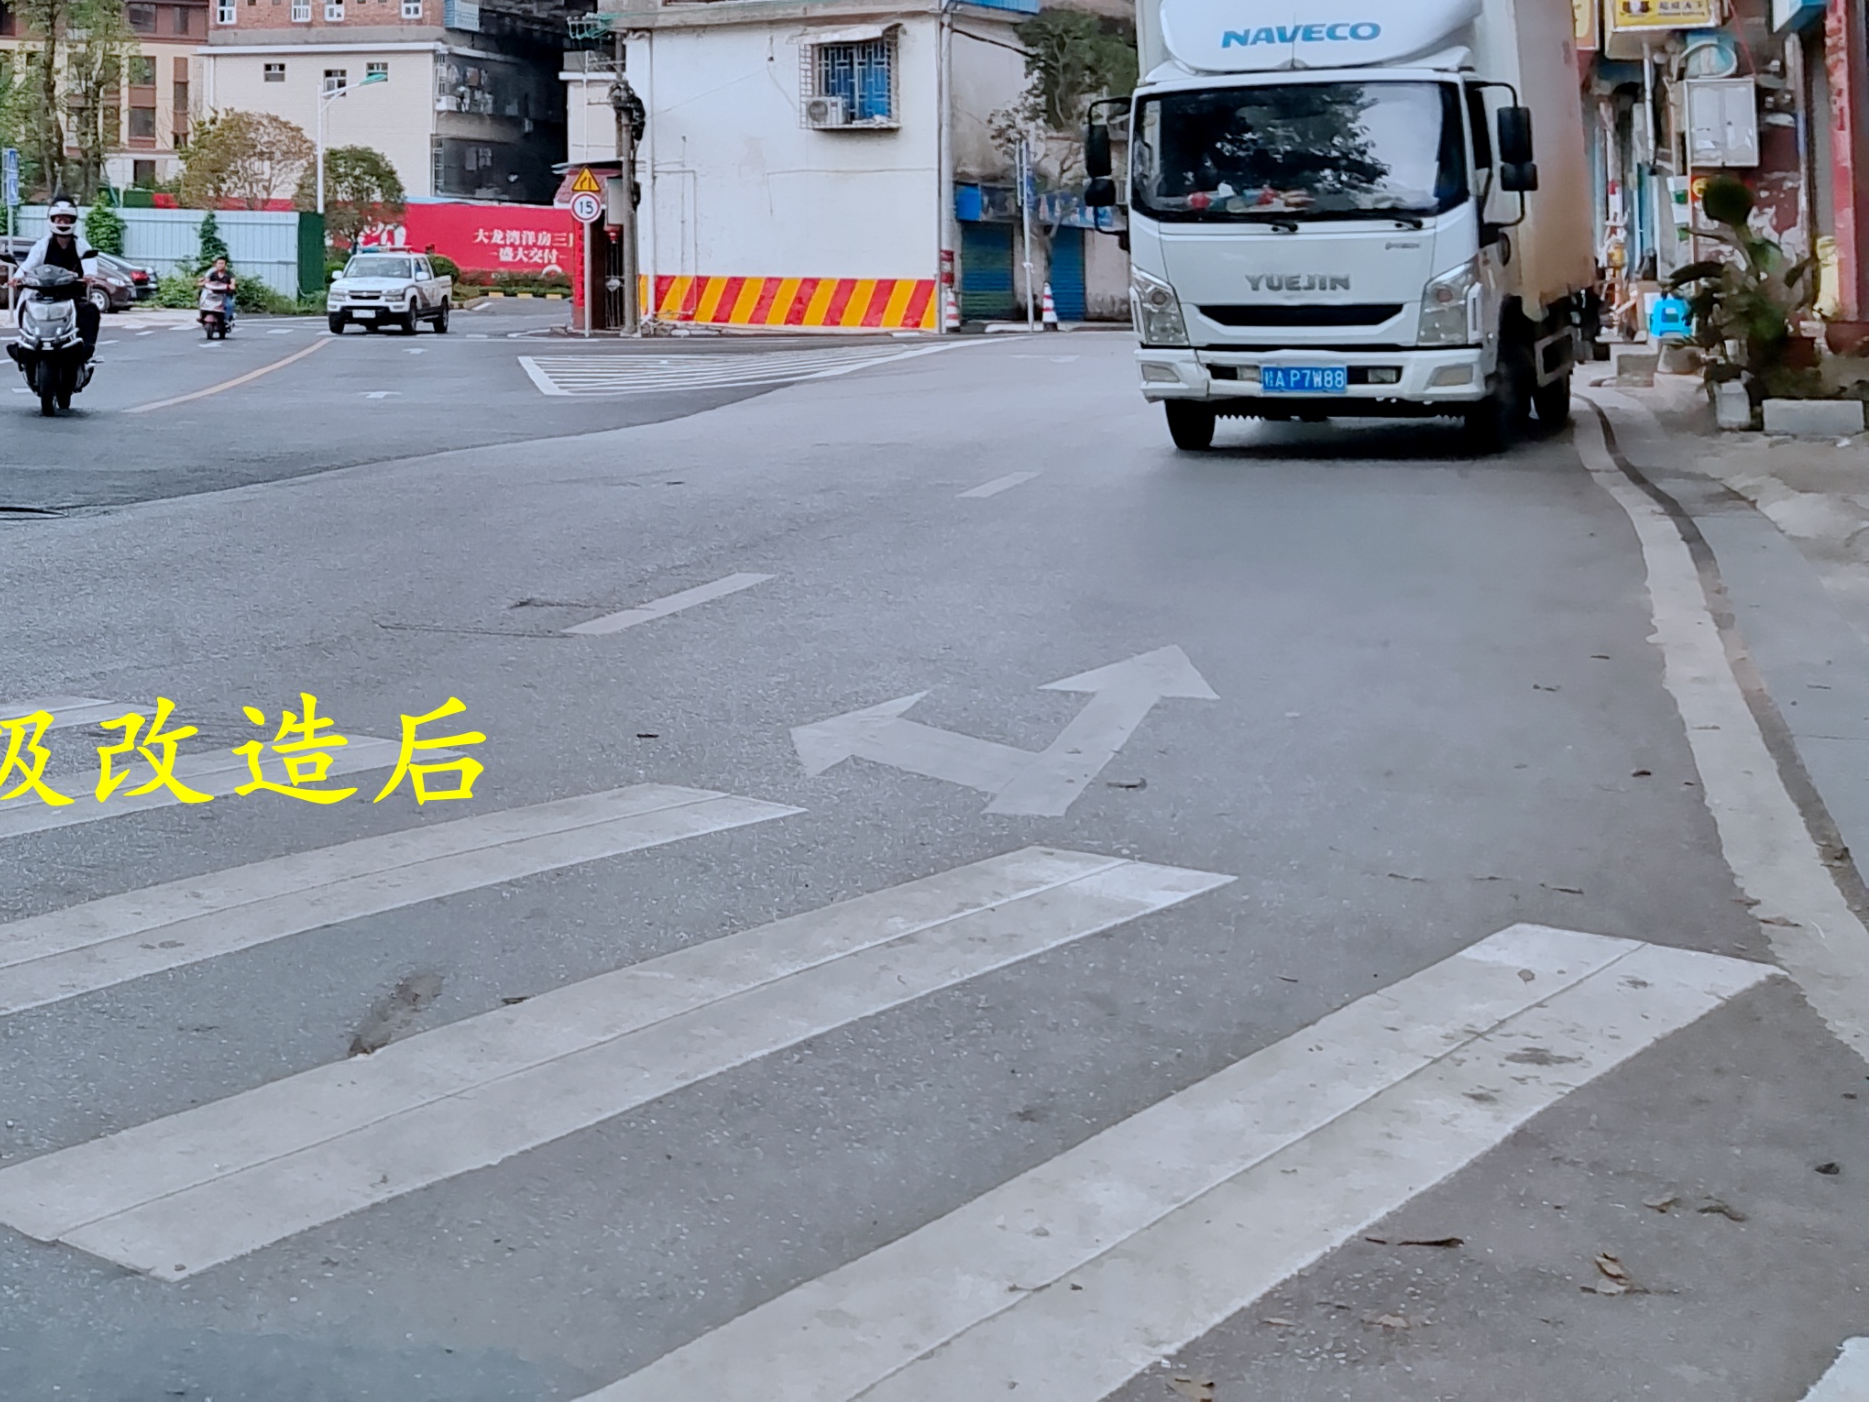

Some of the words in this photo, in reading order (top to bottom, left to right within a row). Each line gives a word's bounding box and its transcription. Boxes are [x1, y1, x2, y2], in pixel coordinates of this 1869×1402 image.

[1222, 22, 1382, 48] NAVECO
[579, 201, 594, 215] 15
[472, 228, 574, 248] 大龙湾洋房三
[1245, 274, 1351, 291] YUEJIN
